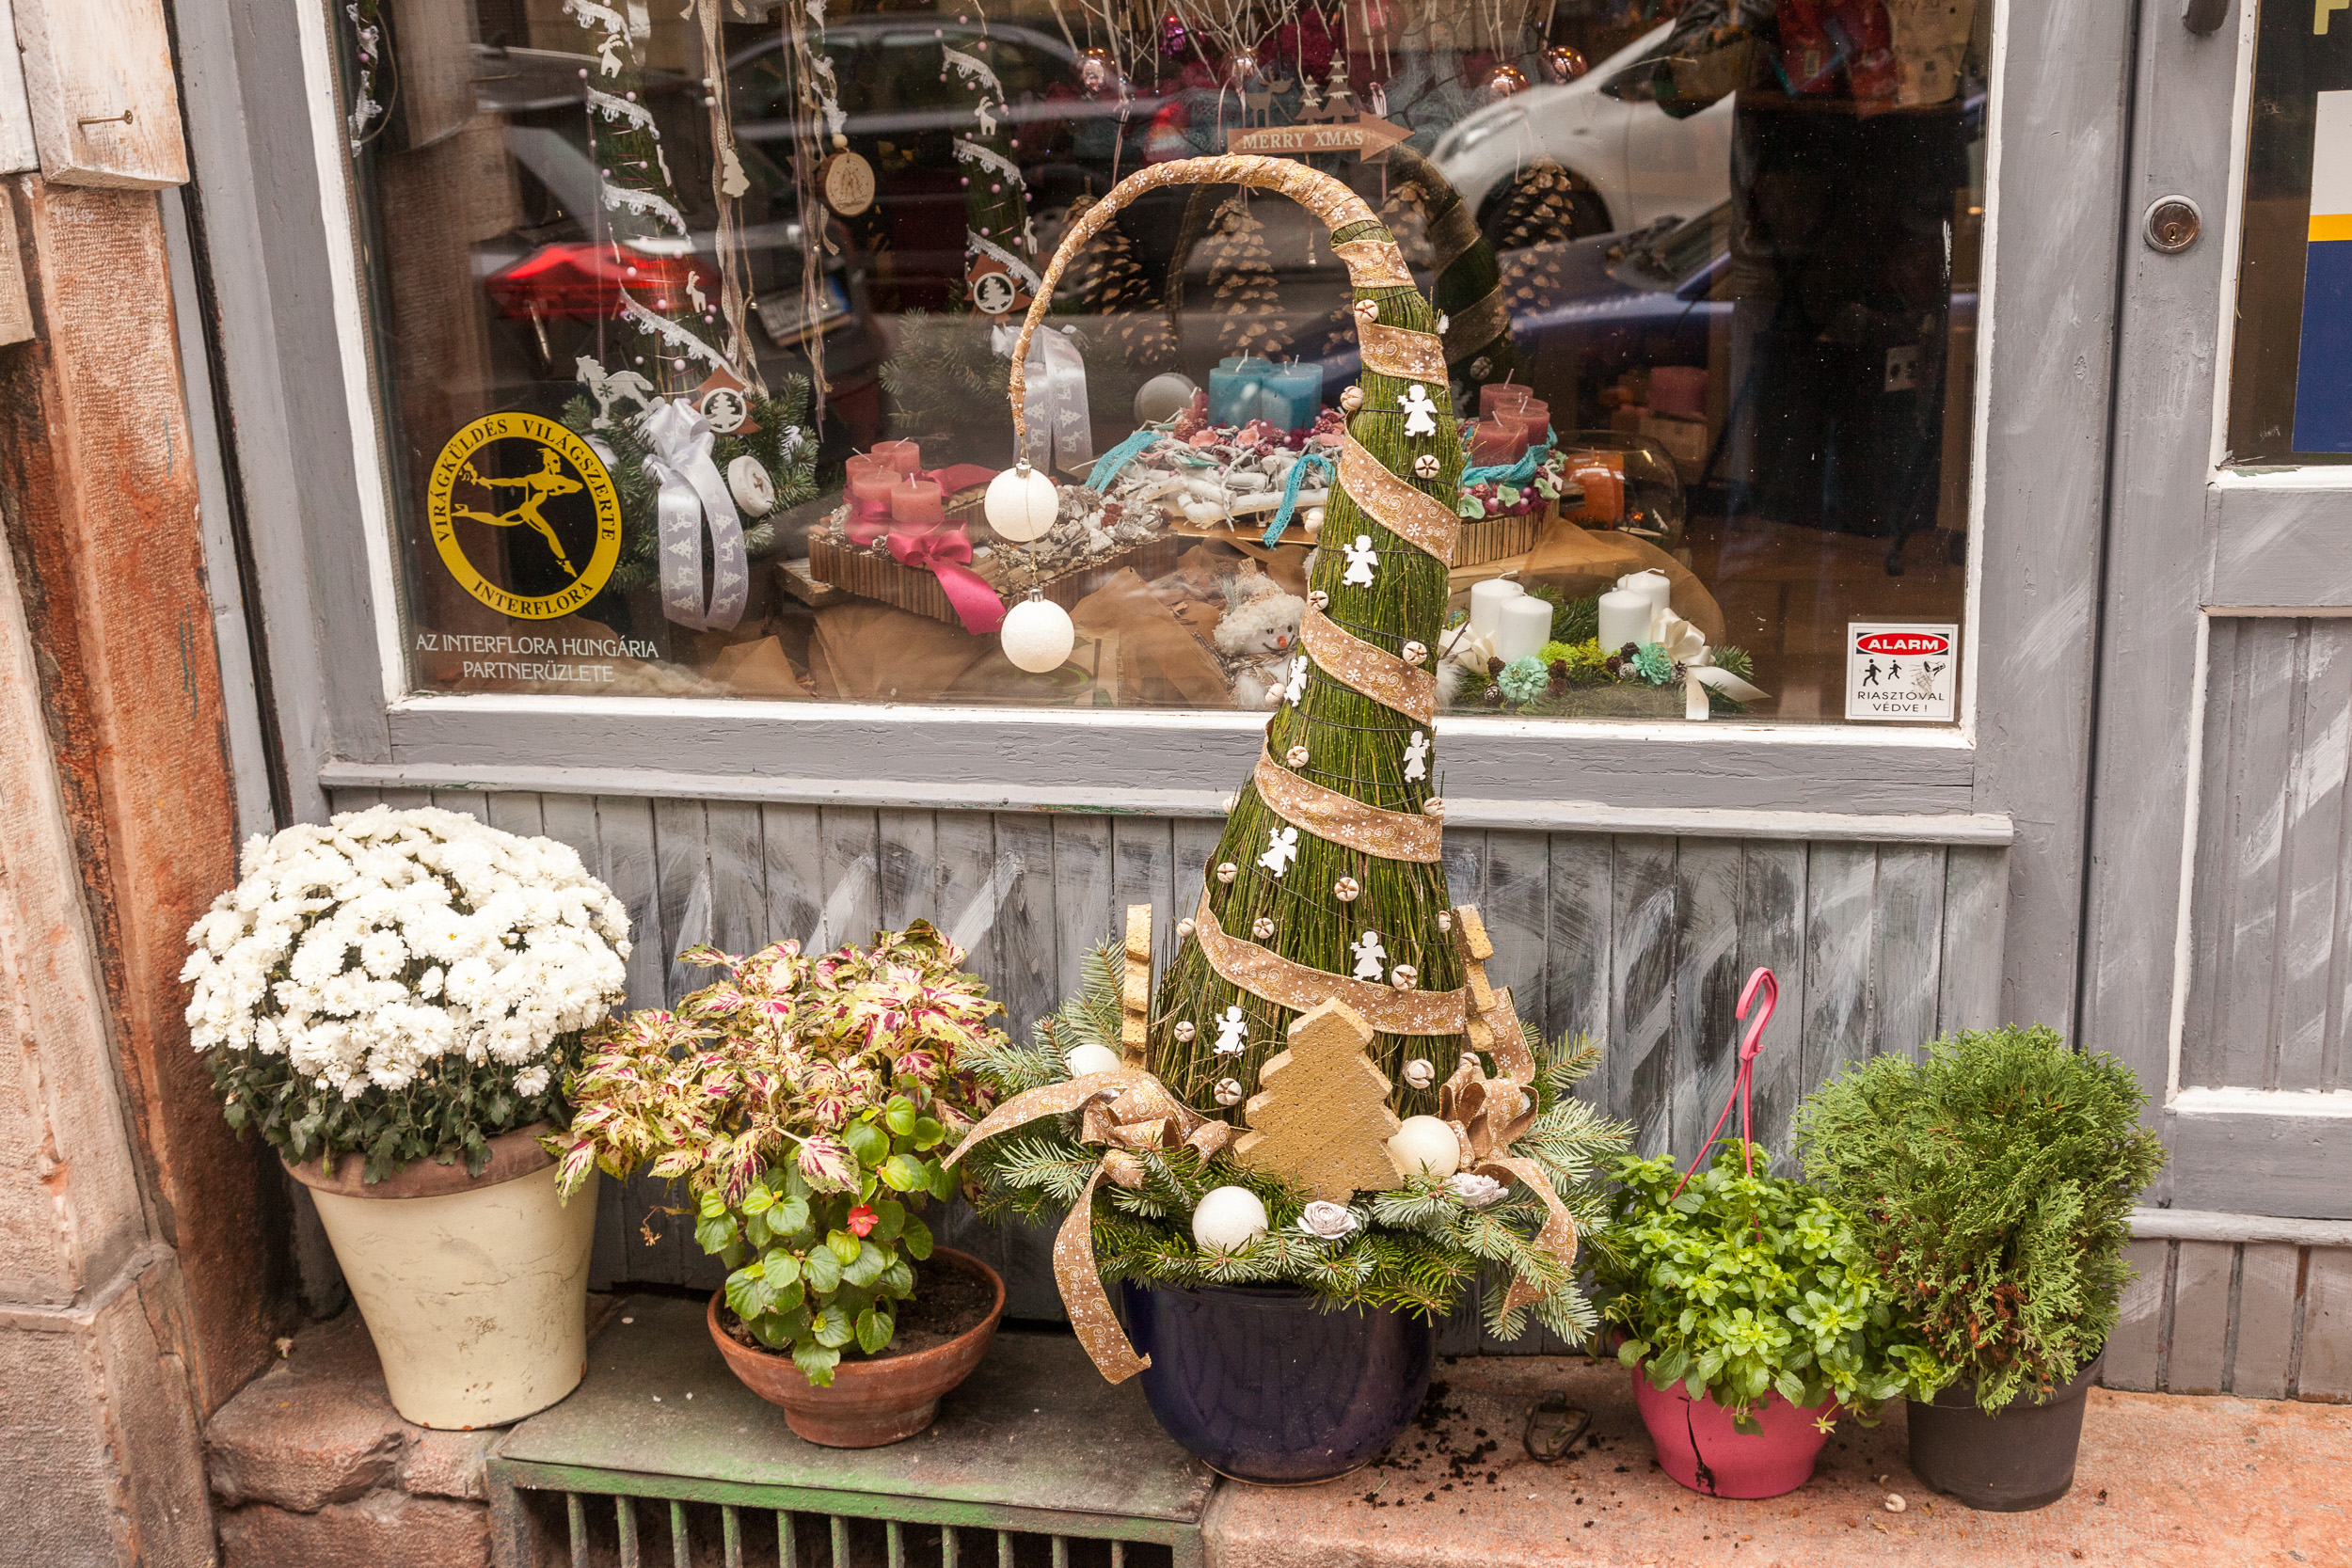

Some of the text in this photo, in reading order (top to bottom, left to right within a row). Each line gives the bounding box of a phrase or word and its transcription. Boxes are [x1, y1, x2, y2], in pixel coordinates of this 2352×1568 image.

[1242, 130, 1364, 150] MERRY XMAS
[429, 418, 615, 543] VIRÁGKÜLDÉS VILÁGSZERTE
[473, 580, 594, 615] INTERFLORA
[415, 633, 660, 658] AZ INTERFLORA HUNGÁRIA
[1867, 639, 1939, 650] ALARM
[463, 660, 615, 683] PARTNERÜZLETE
[1857, 689, 1945, 701] RIASZTÓVAL
